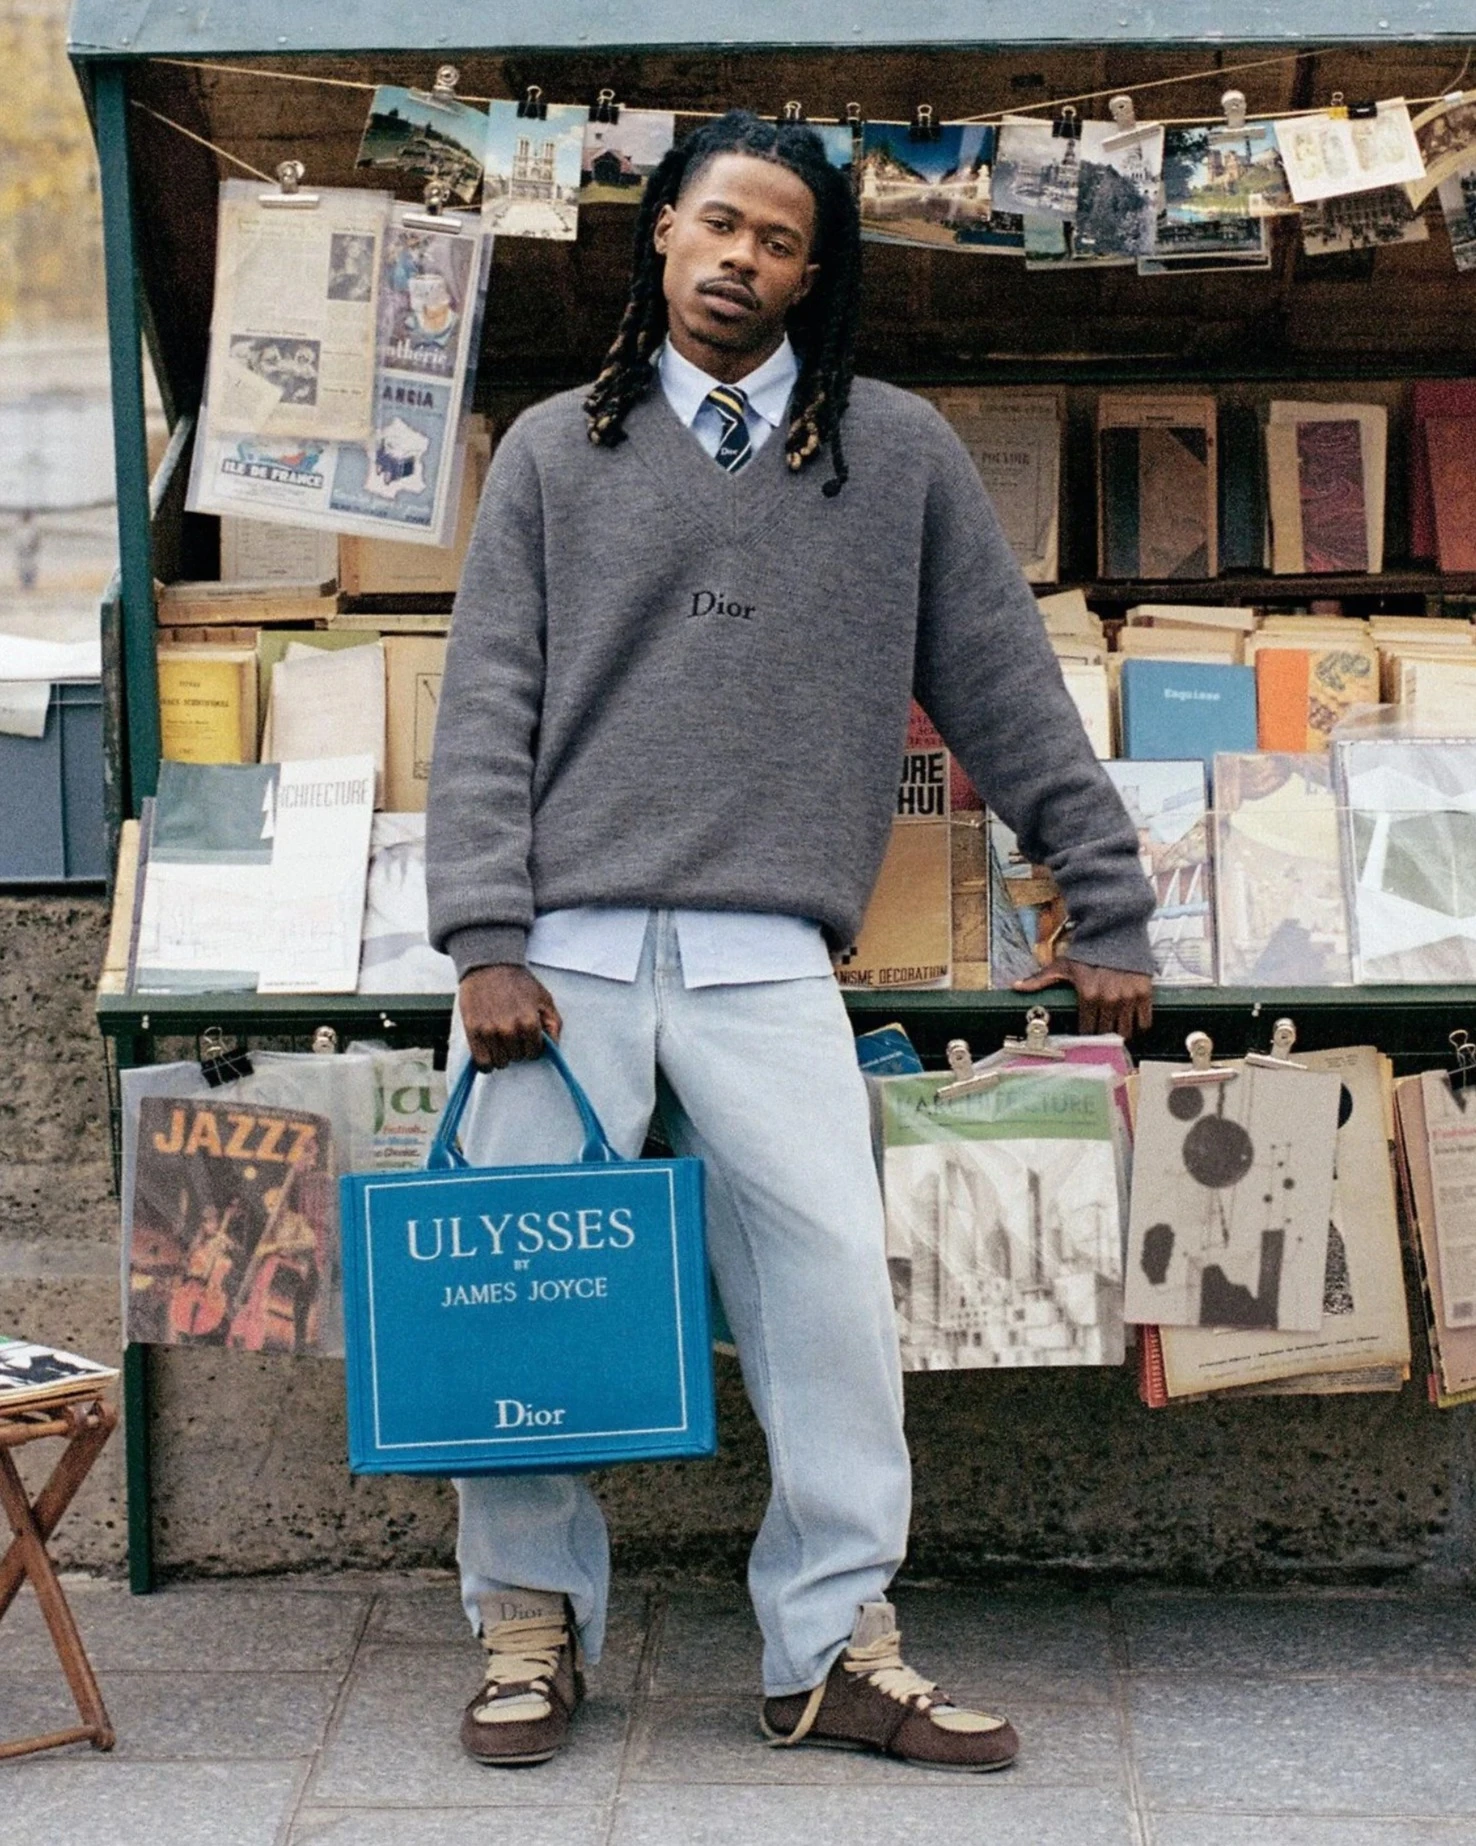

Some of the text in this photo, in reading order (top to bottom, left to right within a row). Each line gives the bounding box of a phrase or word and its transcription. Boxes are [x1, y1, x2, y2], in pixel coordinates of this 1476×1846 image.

[250, 466, 268, 480] DE
[270, 468, 322, 487] FRANCE
[687, 591, 756, 620] Dior
[898, 785, 944, 816] HUI
[406, 1207, 636, 1261] ULYSSES
[513, 1259, 531, 1271] BY
[441, 1276, 609, 1308] JAMES JOYCE
[494, 1398, 566, 1429] Dior
[500, 1602, 543, 1620] Dior
